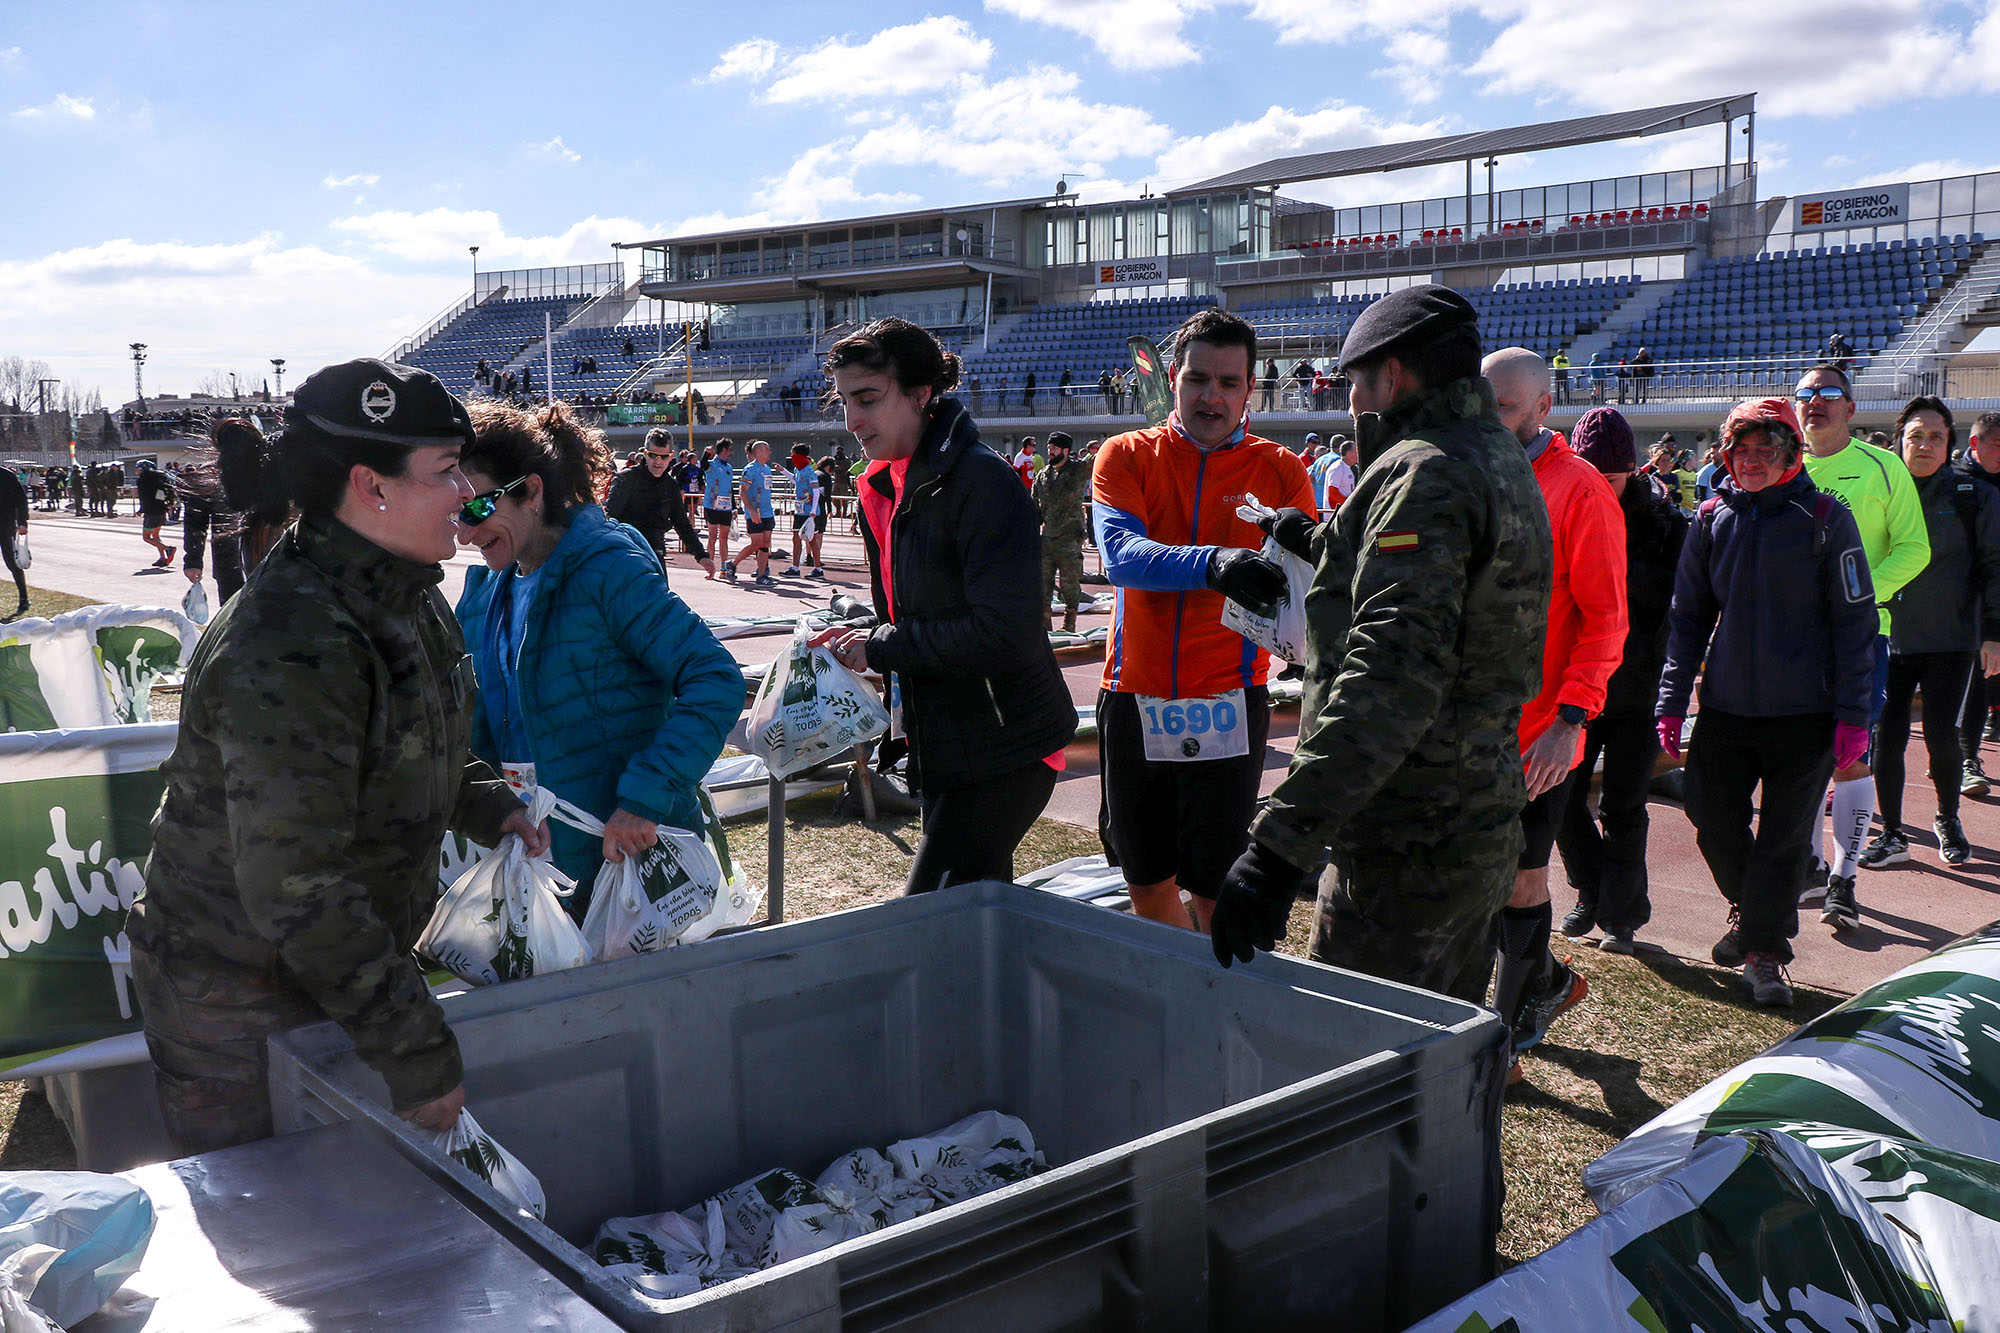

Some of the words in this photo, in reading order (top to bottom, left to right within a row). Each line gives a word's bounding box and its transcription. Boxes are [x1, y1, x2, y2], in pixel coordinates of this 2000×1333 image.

[1825, 194, 1889, 211] GOBIERNO
[1824, 212, 1841, 224] DE
[1845, 205, 1898, 221] ARAGON
[1115, 262, 1156, 273] GOBIERNO
[1115, 273, 1126, 282] DE
[1128, 271, 1162, 281] ARAGON
[623, 406, 657, 414] CARRERA
[1145, 701, 1237, 735] 1690
[672, 906, 702, 927] TODOS
